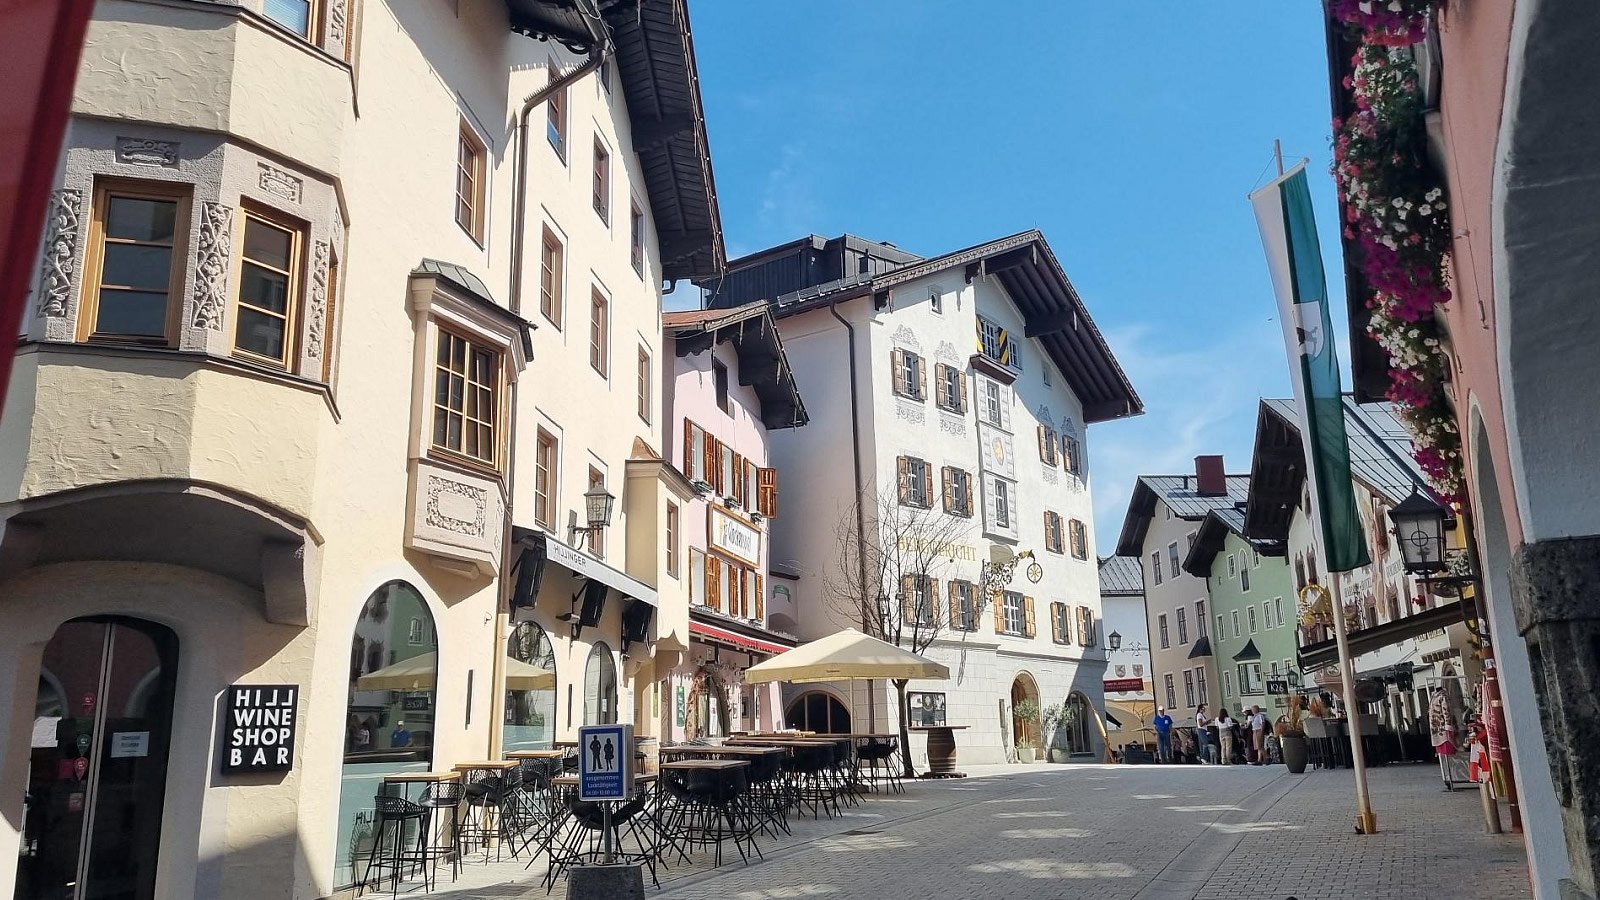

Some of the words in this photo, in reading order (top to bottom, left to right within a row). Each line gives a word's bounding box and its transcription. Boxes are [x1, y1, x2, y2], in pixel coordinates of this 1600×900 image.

[1270, 683, 1285, 693] K26
[236, 690, 293, 707] HILL
[234, 708, 292, 726] WINE
[231, 728, 291, 746] SHOP
[230, 747, 289, 766] BAR
